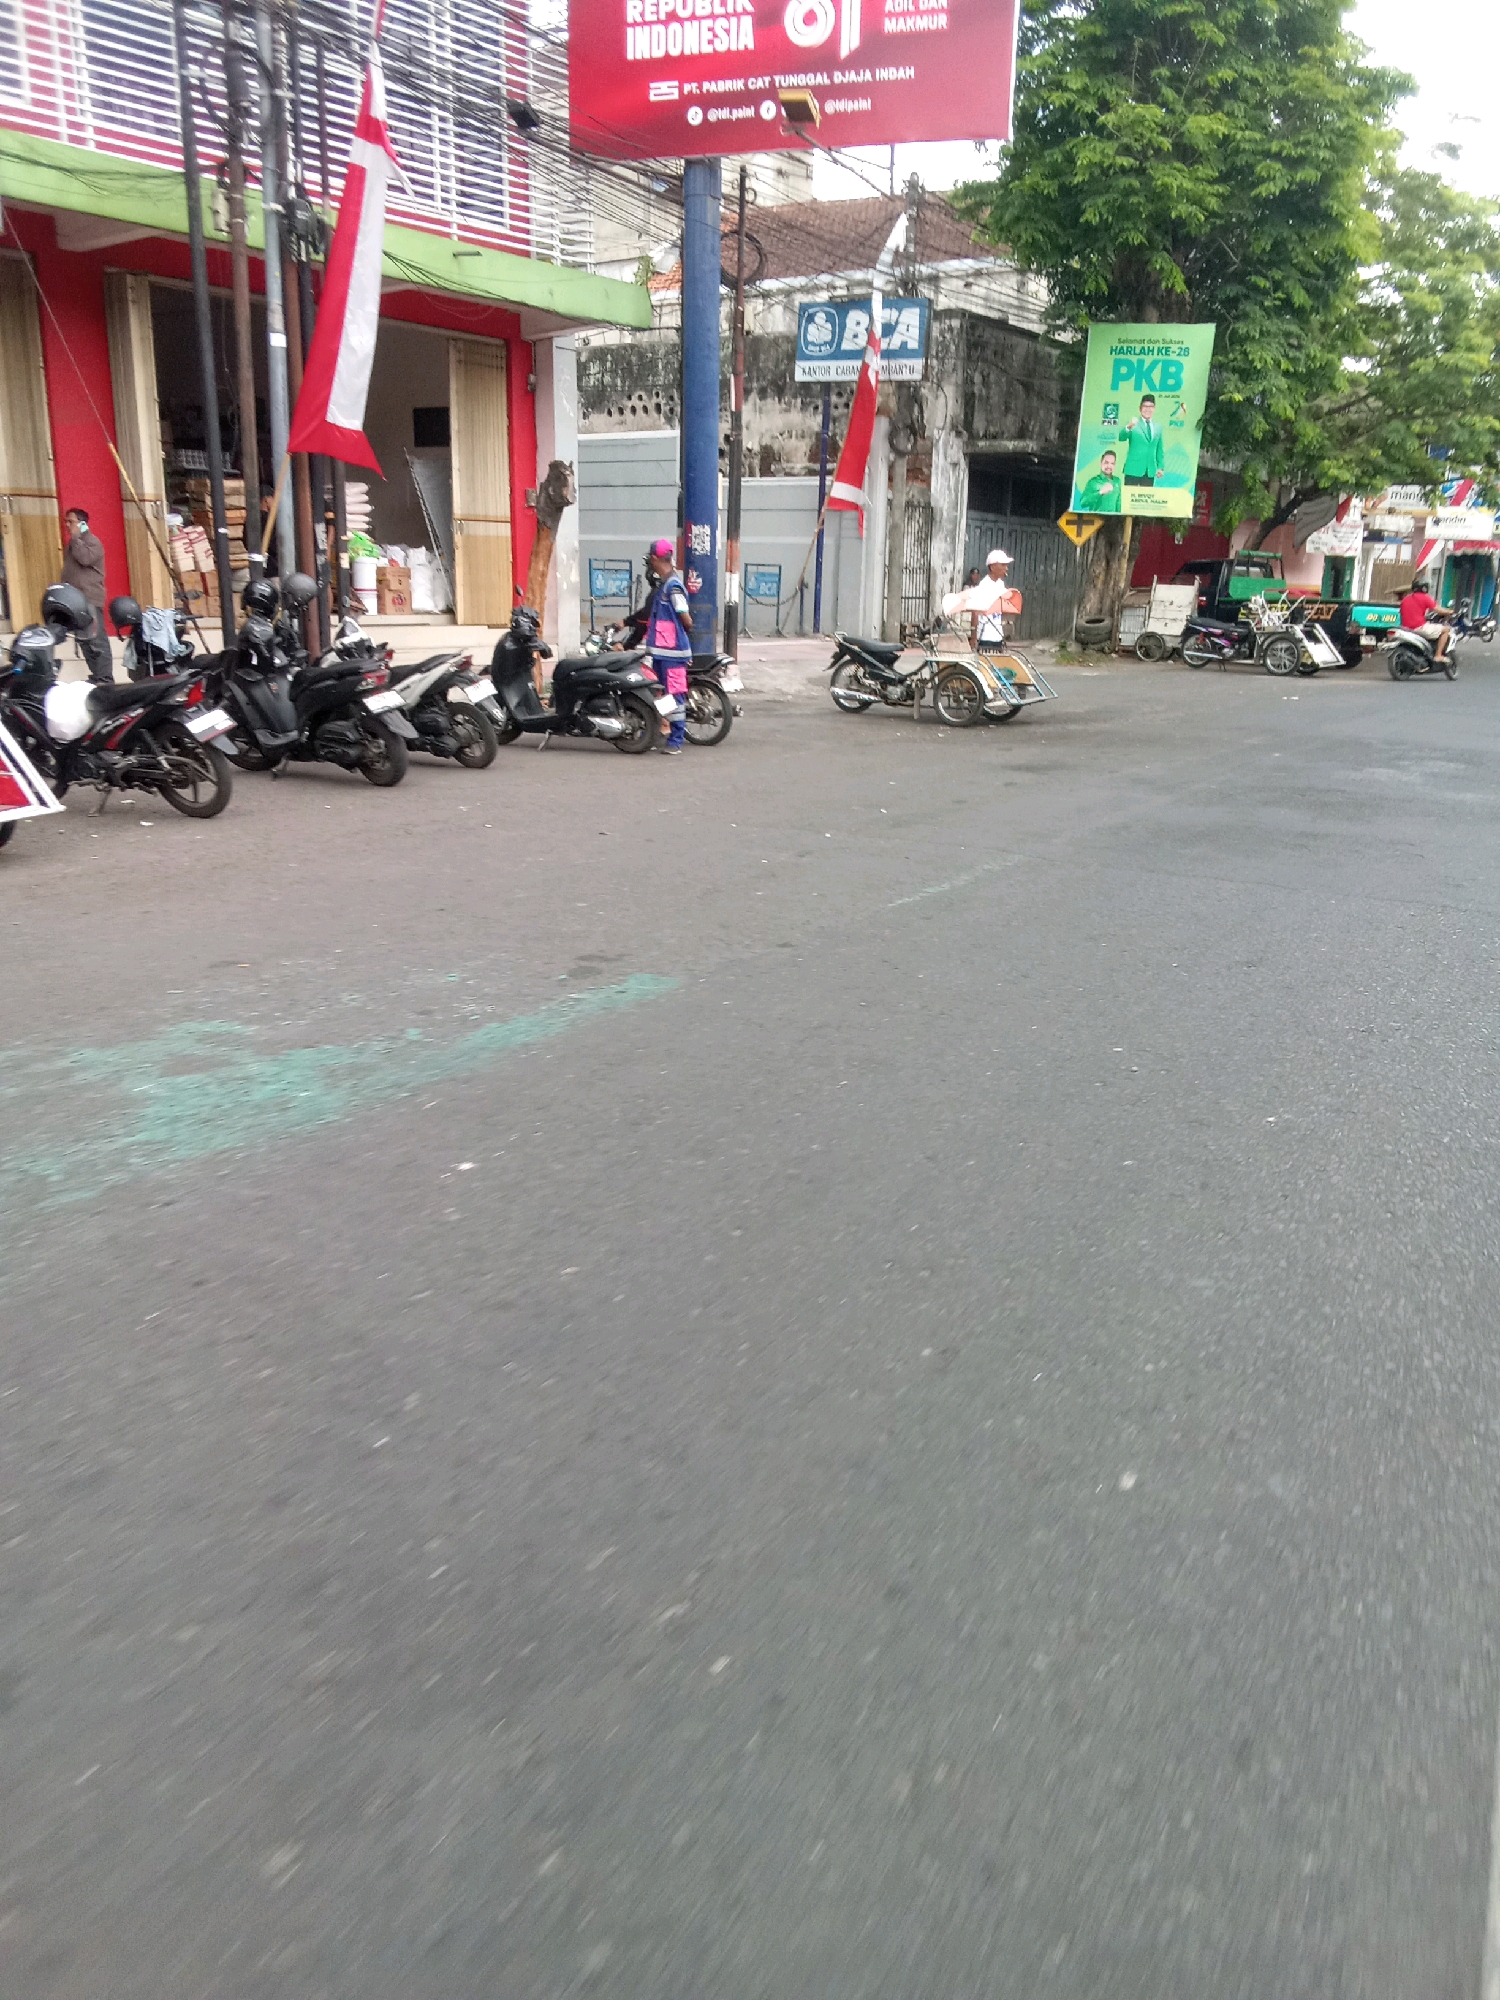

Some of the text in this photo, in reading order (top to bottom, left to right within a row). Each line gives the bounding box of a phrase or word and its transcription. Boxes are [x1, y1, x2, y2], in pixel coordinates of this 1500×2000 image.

[884, 13, 948, 33] MAKMUR
[626, 15, 754, 60] INDONESIA
[683, 66, 915, 94] PT. PABRIK CAT TUNGGAL DJAJA INDAH
[841, 307, 920, 350] BCA
[1110, 346, 1190, 356] HARLAH KE-28
[802, 364, 831, 376] KANTOR
[836, 364, 862, 376] CABAN
[1110, 358, 1185, 392] PKB
